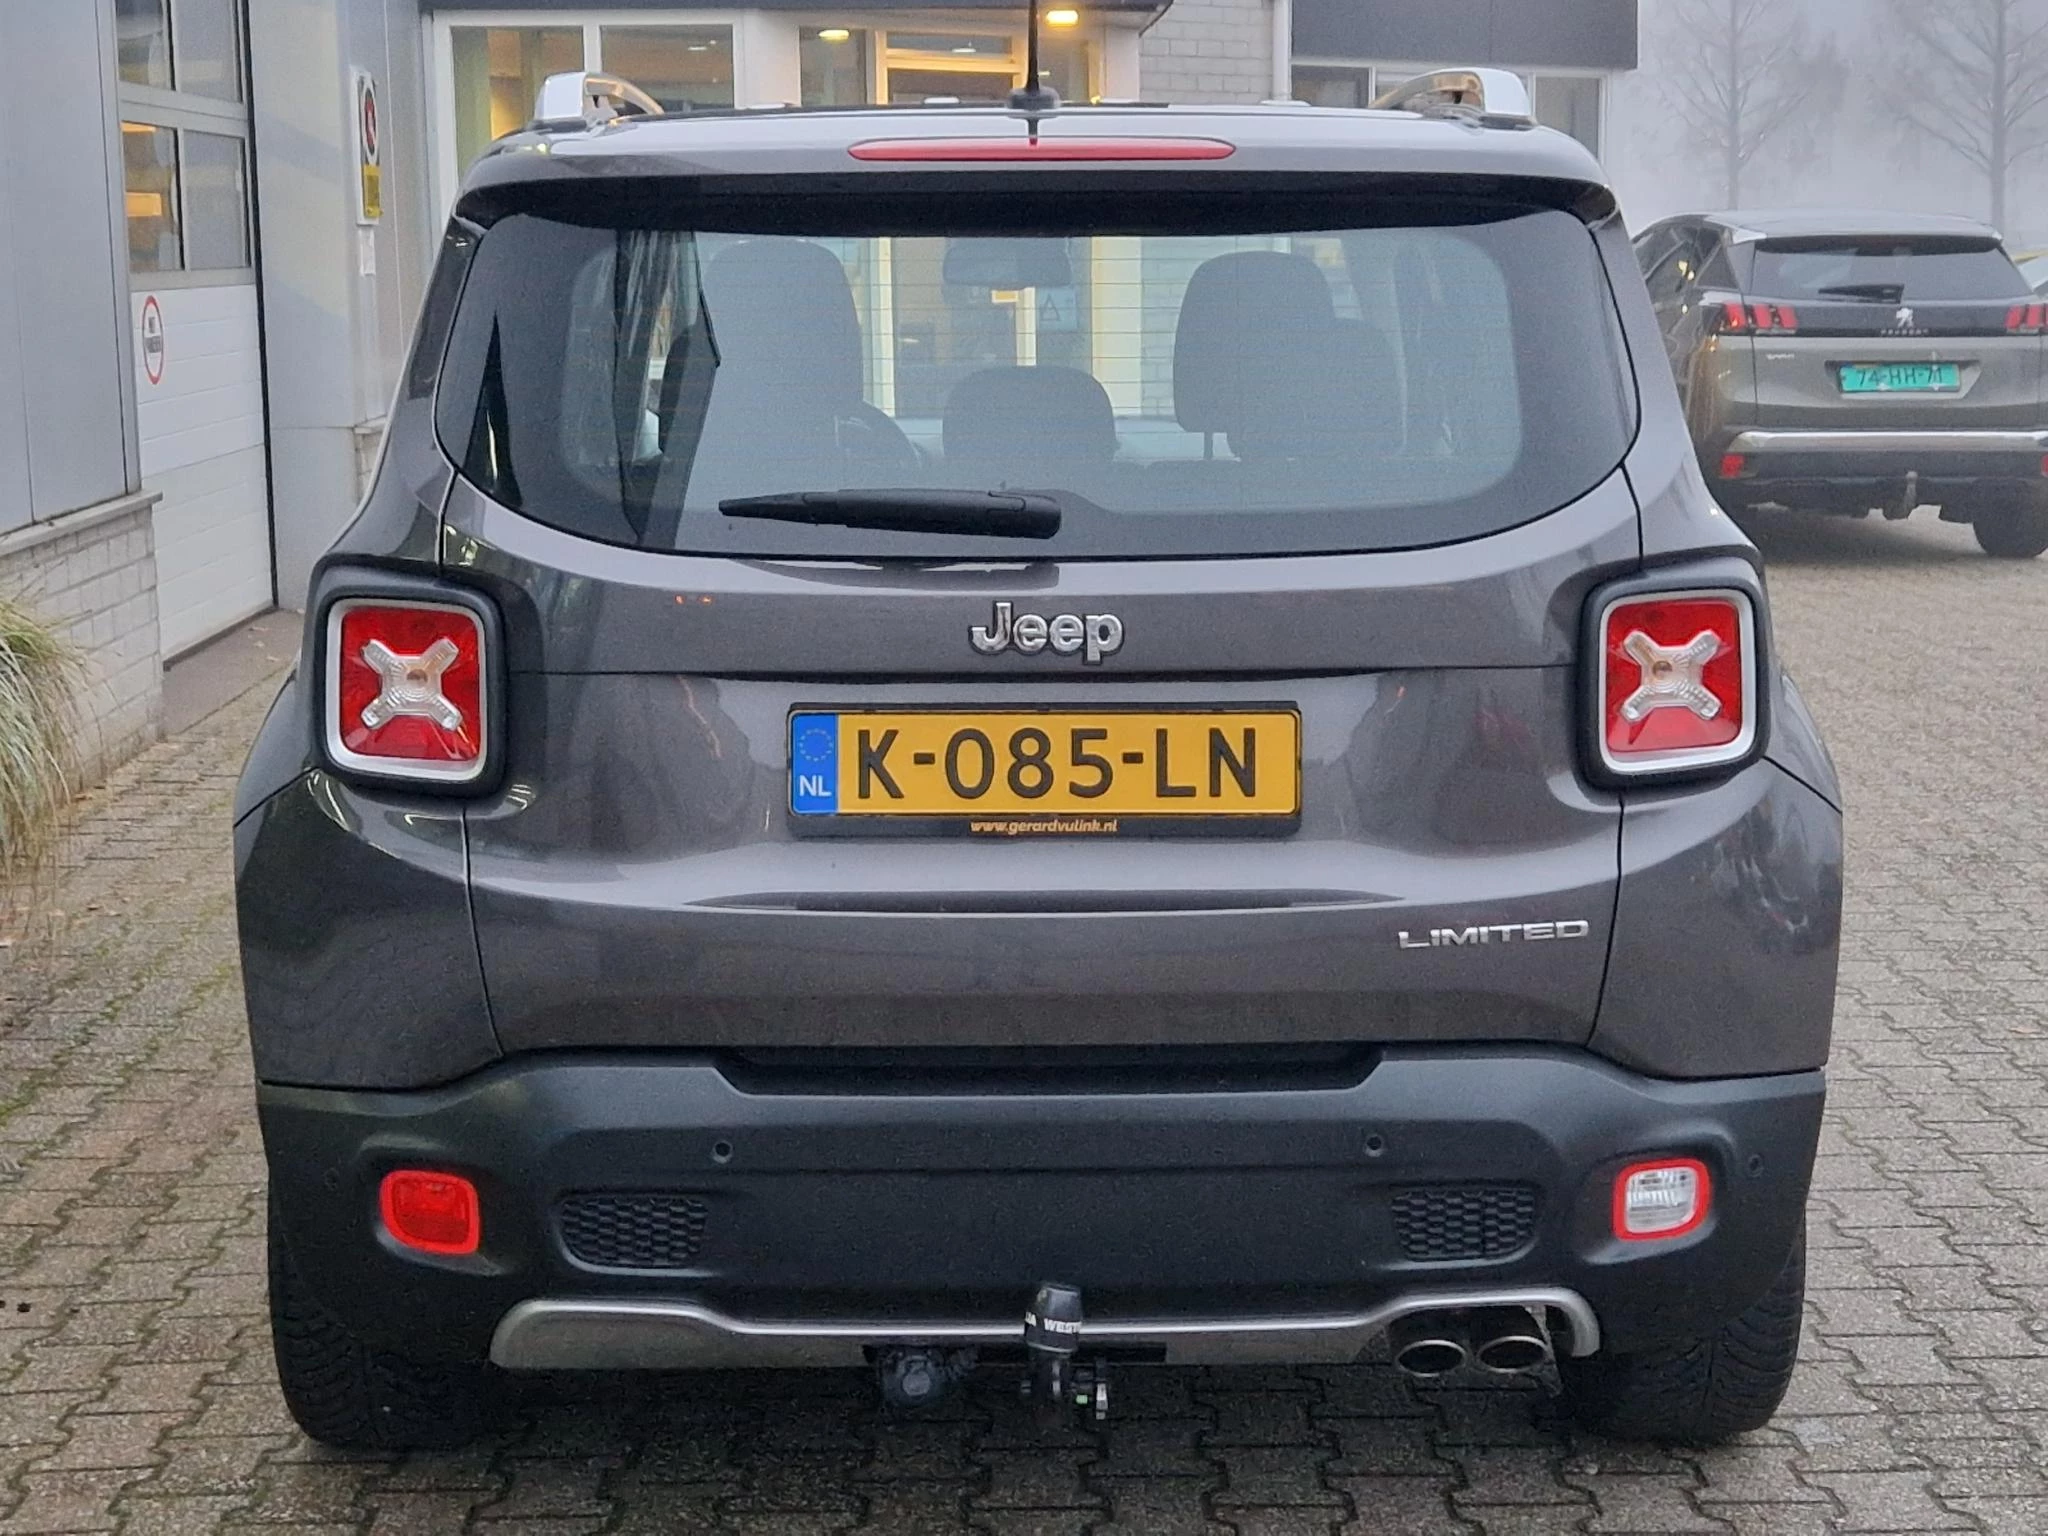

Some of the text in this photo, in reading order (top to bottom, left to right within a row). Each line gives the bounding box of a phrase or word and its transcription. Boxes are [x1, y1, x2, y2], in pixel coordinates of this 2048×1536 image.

[1856, 366, 1943, 388] 74-HH-71
[970, 601, 1123, 664] Jeep
[857, 727, 1256, 800] K-085-LN
[800, 775, 832, 798] NL
[970, 819, 1118, 835] www.gerardvulink.nl
[1398, 919, 1590, 950] LIMITED
